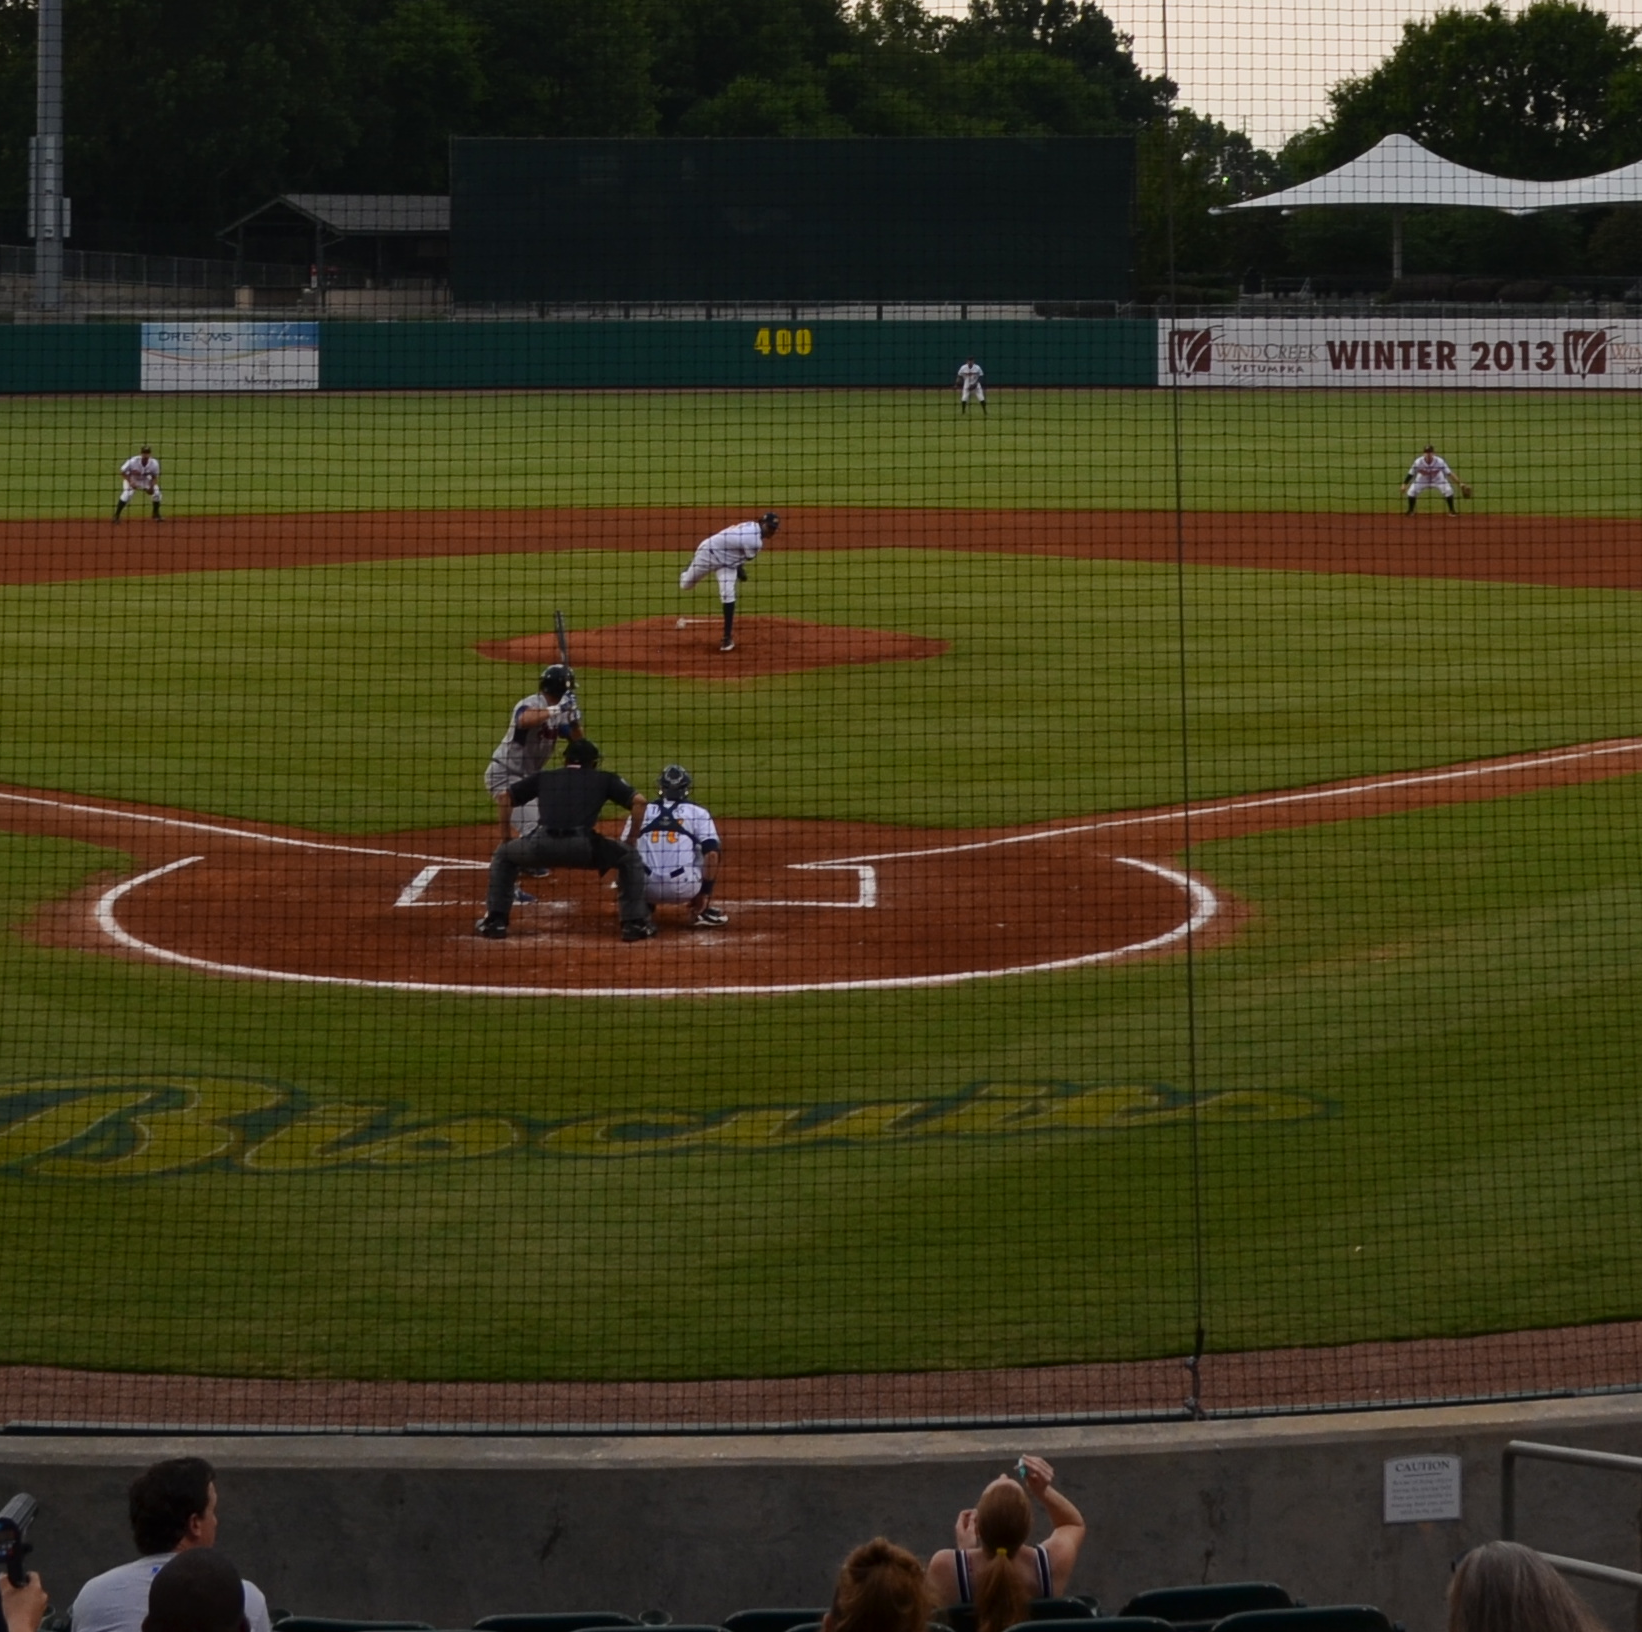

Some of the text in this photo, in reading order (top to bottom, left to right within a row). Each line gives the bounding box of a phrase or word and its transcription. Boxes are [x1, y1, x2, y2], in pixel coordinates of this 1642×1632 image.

[753, 327, 813, 355] 400
[1326, 341, 1555, 371] WINTER 2013
[1395, 1460, 1451, 1472] CAUTION
